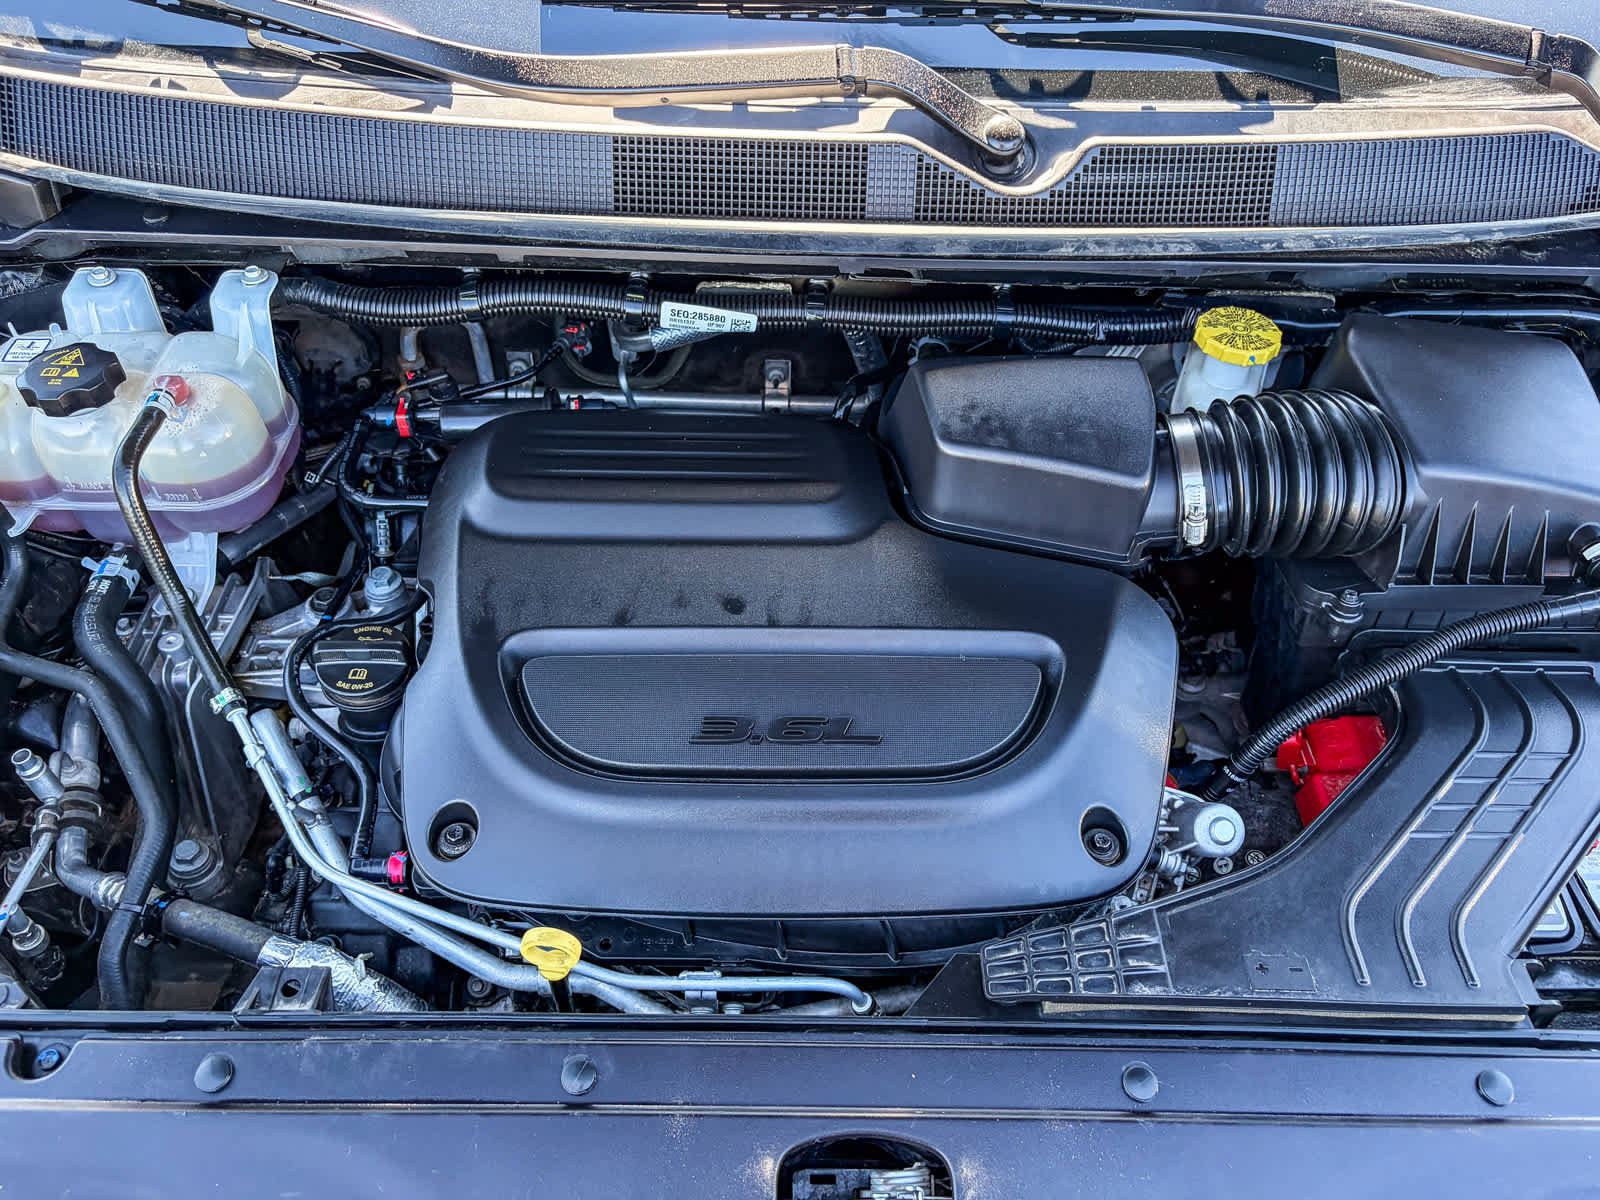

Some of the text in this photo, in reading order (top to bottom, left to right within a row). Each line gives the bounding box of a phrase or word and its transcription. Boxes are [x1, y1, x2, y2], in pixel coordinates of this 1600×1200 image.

[670, 308, 726, 323] SEQ:285880
[353, 626, 382, 634] ENGINE
[336, 680, 374, 690] SAE 0W-20
[688, 716, 884, 745] 3.6L
